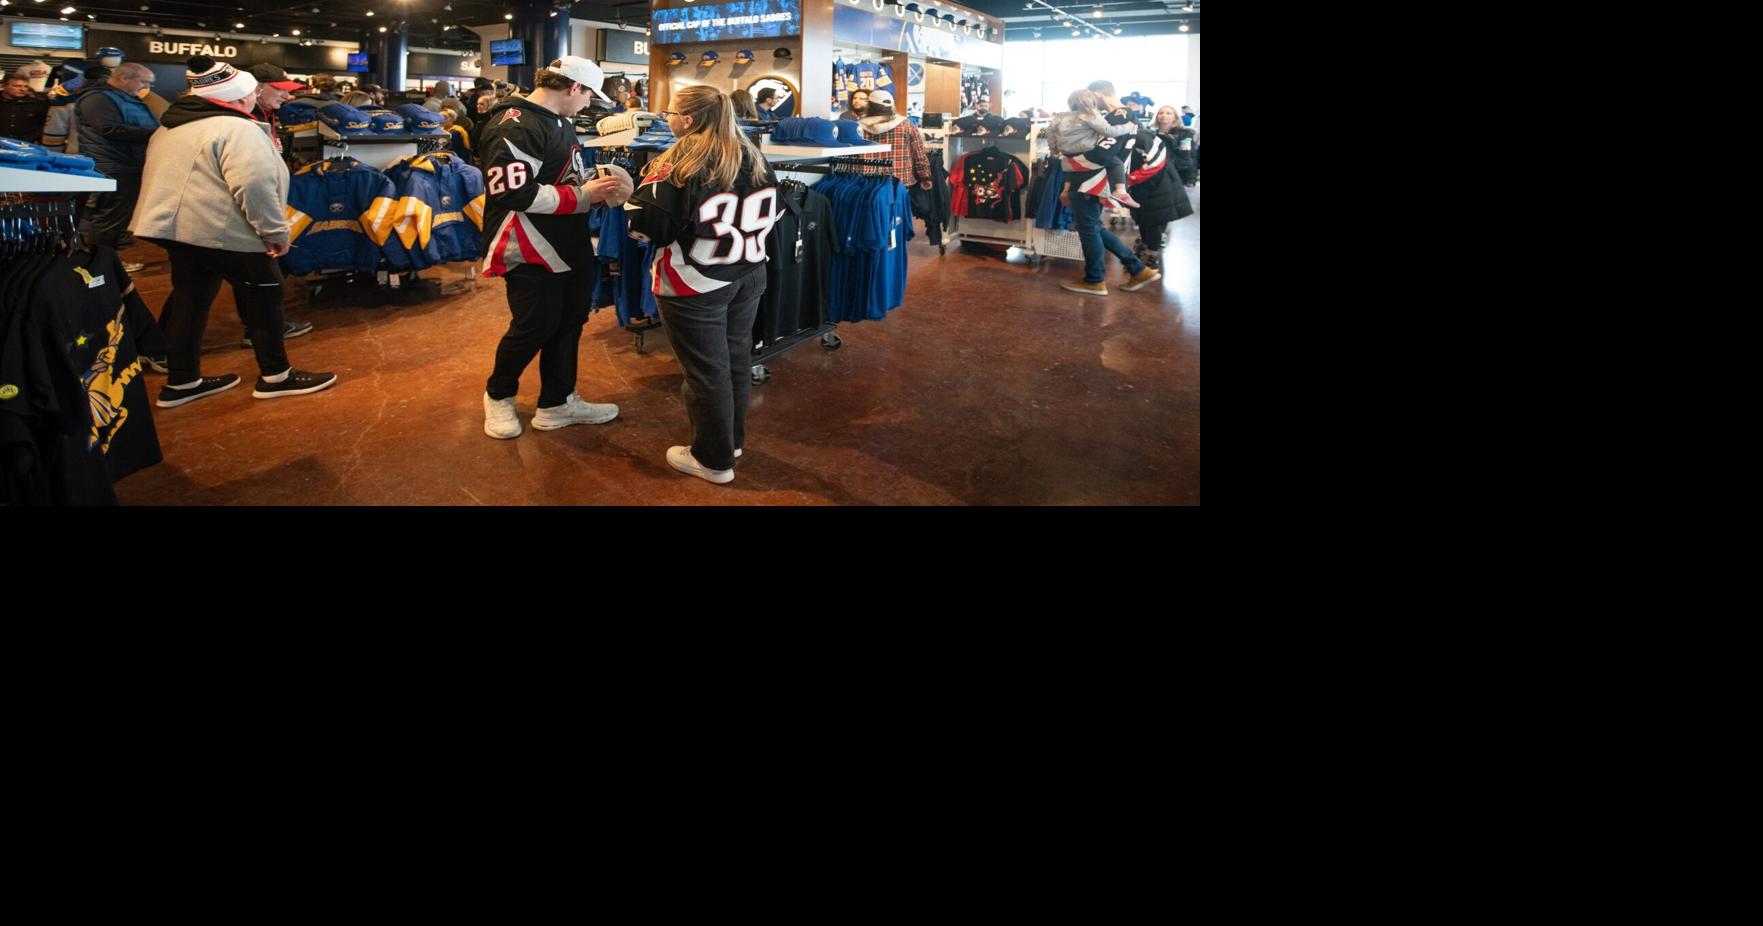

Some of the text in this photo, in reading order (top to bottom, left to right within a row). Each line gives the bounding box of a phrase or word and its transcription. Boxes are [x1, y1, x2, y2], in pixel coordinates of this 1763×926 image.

[658, 12, 792, 31] OFFICIAL CAP OF THE BUFFALO SABRES
[149, 41, 237, 57] BUFFALO
[486, 161, 528, 196] 26
[689, 186, 777, 266] 39
